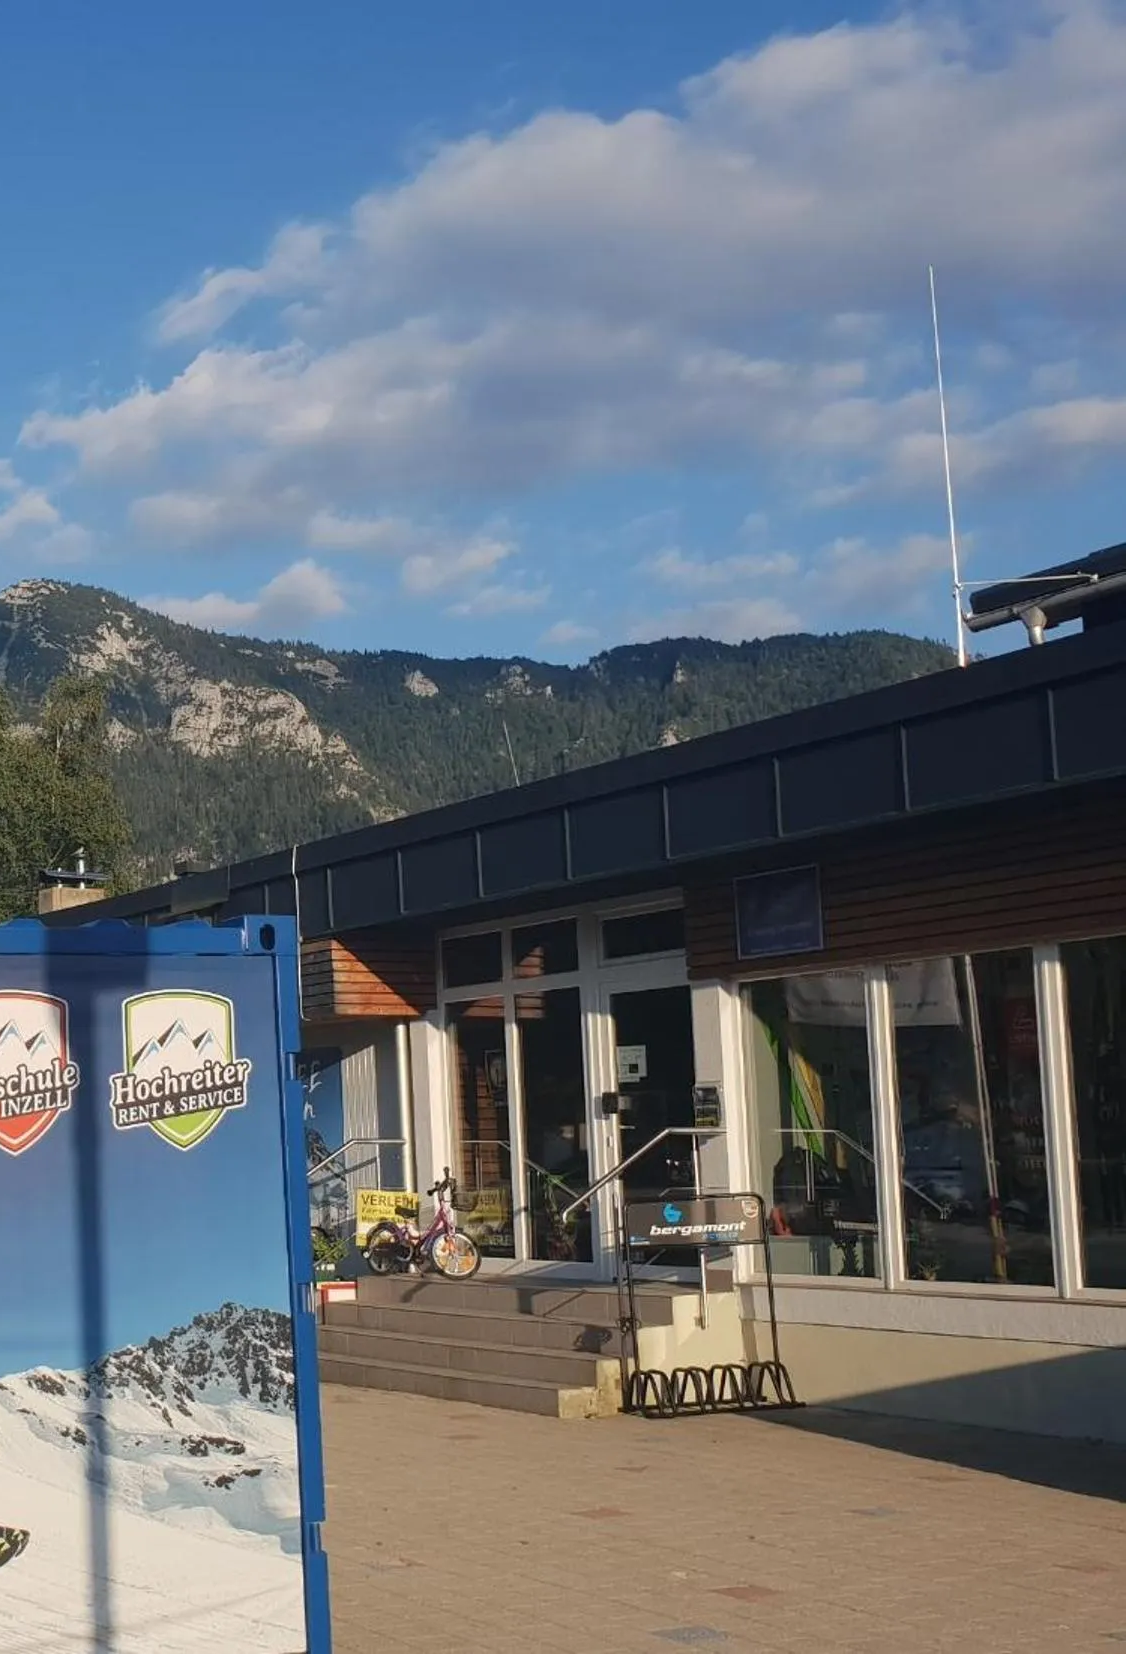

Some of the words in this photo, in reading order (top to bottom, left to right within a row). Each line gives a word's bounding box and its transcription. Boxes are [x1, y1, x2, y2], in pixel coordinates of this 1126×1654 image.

[114, 1061, 248, 1106] Hochreiter
[0, 1088, 67, 1119] INZELL
[117, 1102, 161, 1125] RENT
[163, 1100, 175, 1115] &
[179, 1086, 243, 1113] SERVICE
[649, 1220, 747, 1237] bergamont
